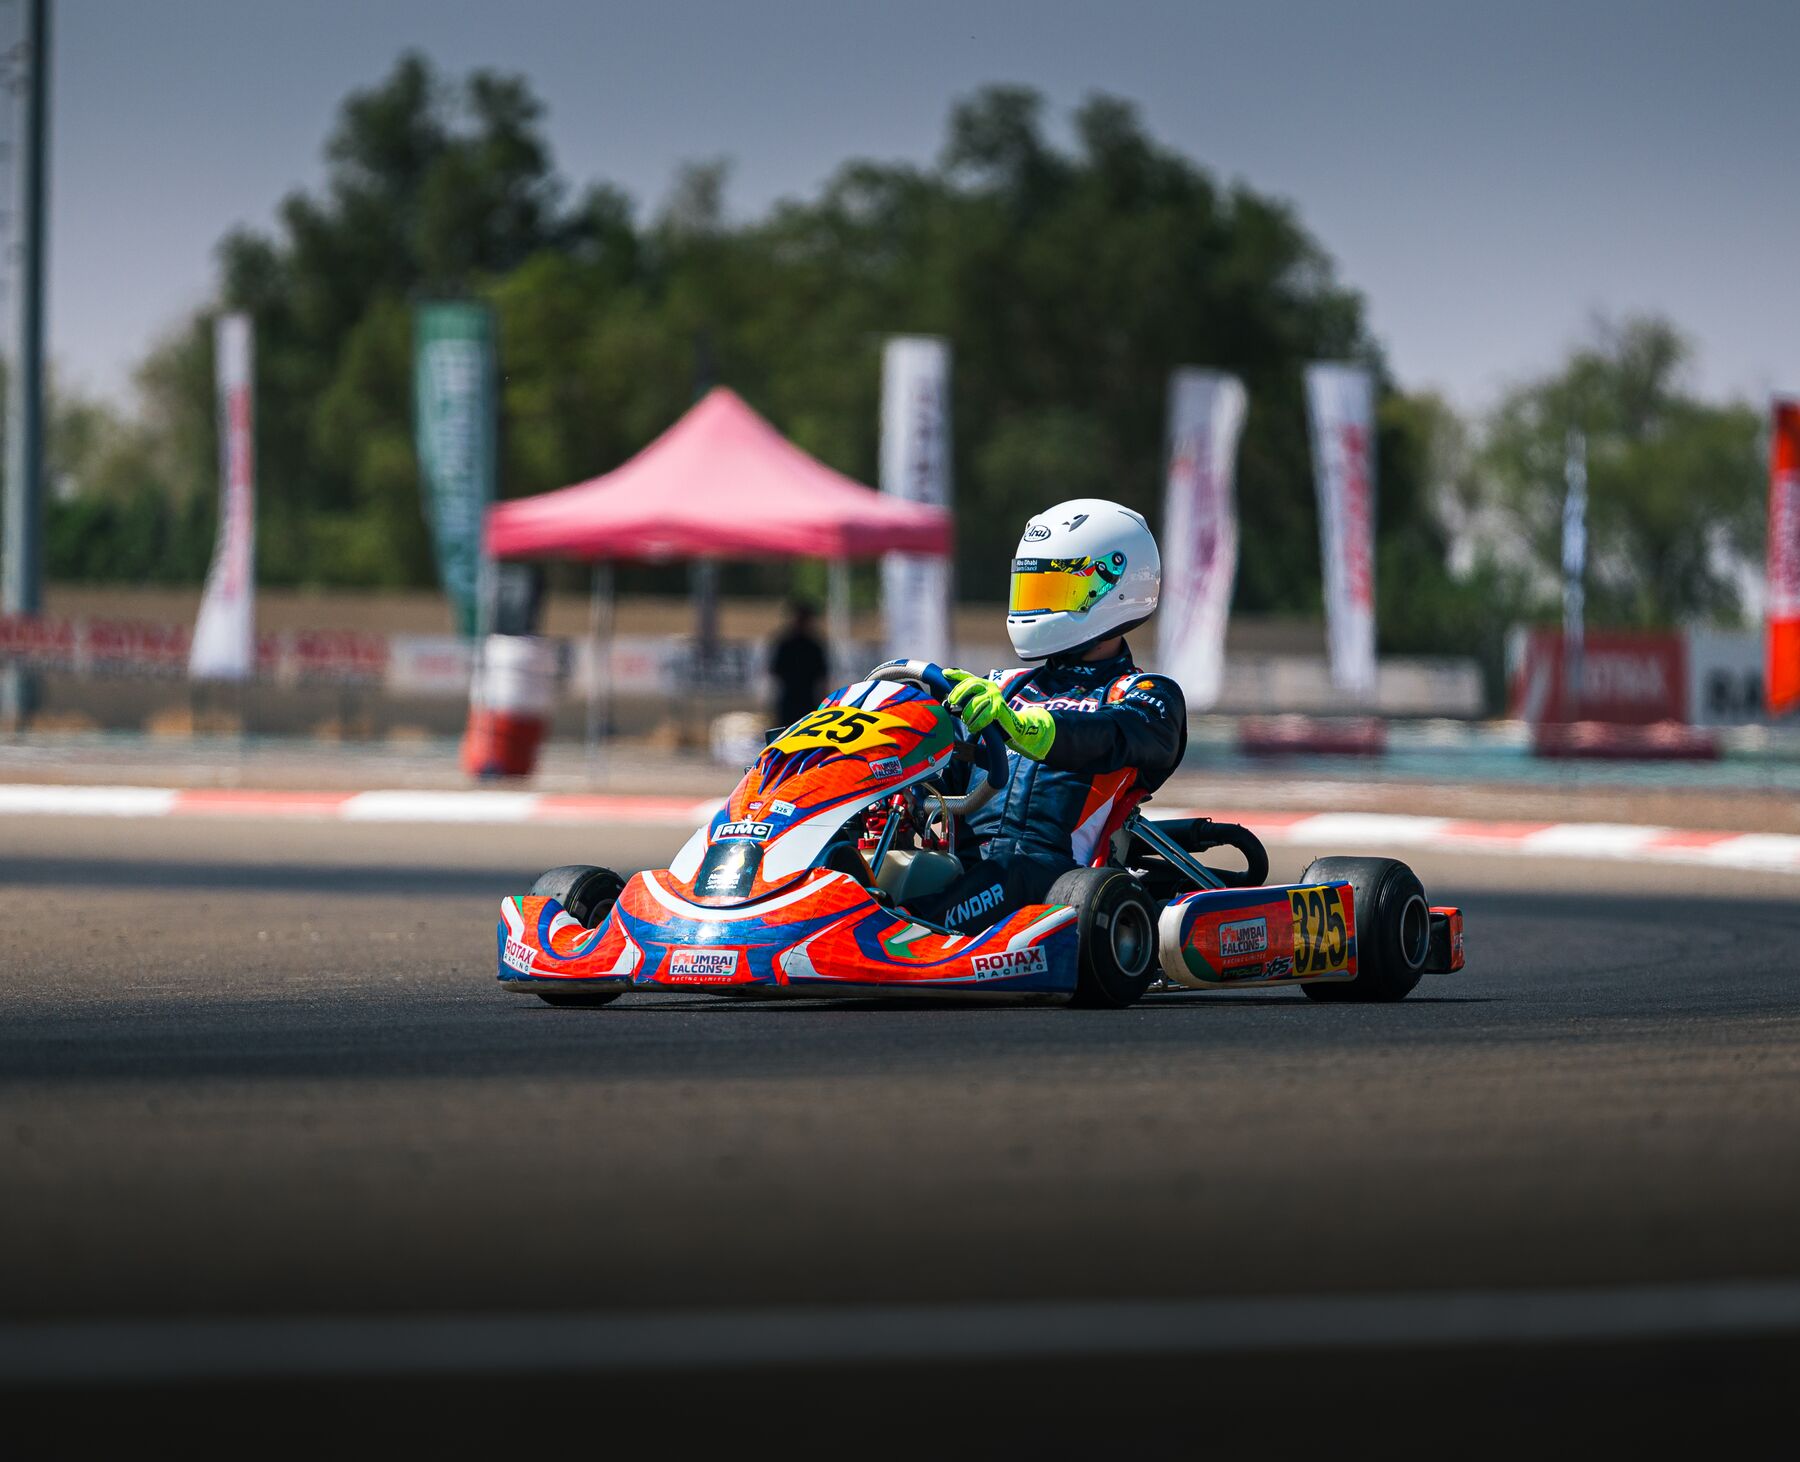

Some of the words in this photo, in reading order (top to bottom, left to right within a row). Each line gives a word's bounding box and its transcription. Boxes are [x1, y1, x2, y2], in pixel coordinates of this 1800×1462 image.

[721, 824, 768, 836] RMC
[944, 883, 1004, 929] KNORR
[1293, 887, 1347, 973] 325
[506, 939, 534, 964] ROTAX
[1222, 940, 1260, 955] FALCONS
[672, 964, 723, 974] FALCONS
[974, 948, 1041, 972] ROTAX
[977, 963, 1044, 979] RACING
